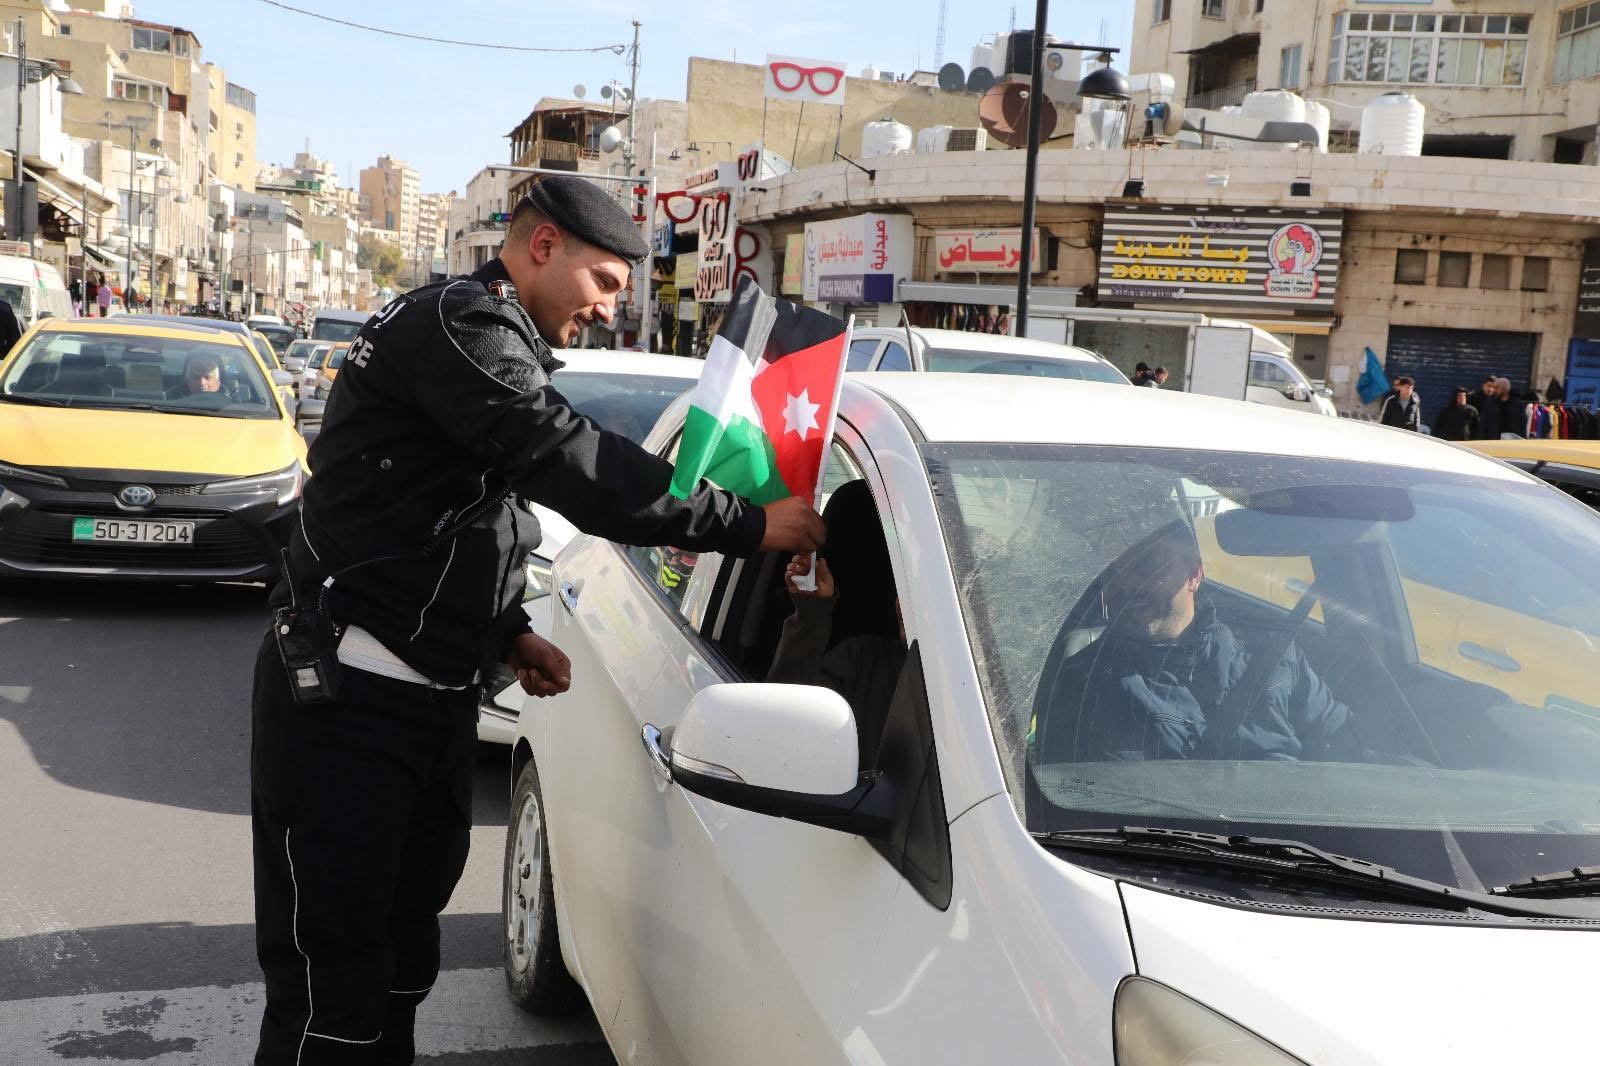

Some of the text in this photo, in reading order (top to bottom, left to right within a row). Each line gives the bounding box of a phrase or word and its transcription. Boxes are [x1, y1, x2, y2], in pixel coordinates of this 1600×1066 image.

[839, 232, 864, 262] صيدلية
[870, 220, 888, 270] صيدلية
[940, 237, 1036, 268] ارياض
[1114, 234, 1249, 264] وسط المدينة
[834, 279, 863, 298] PHARMACY
[1112, 264, 1249, 284] DOWNTOWN
